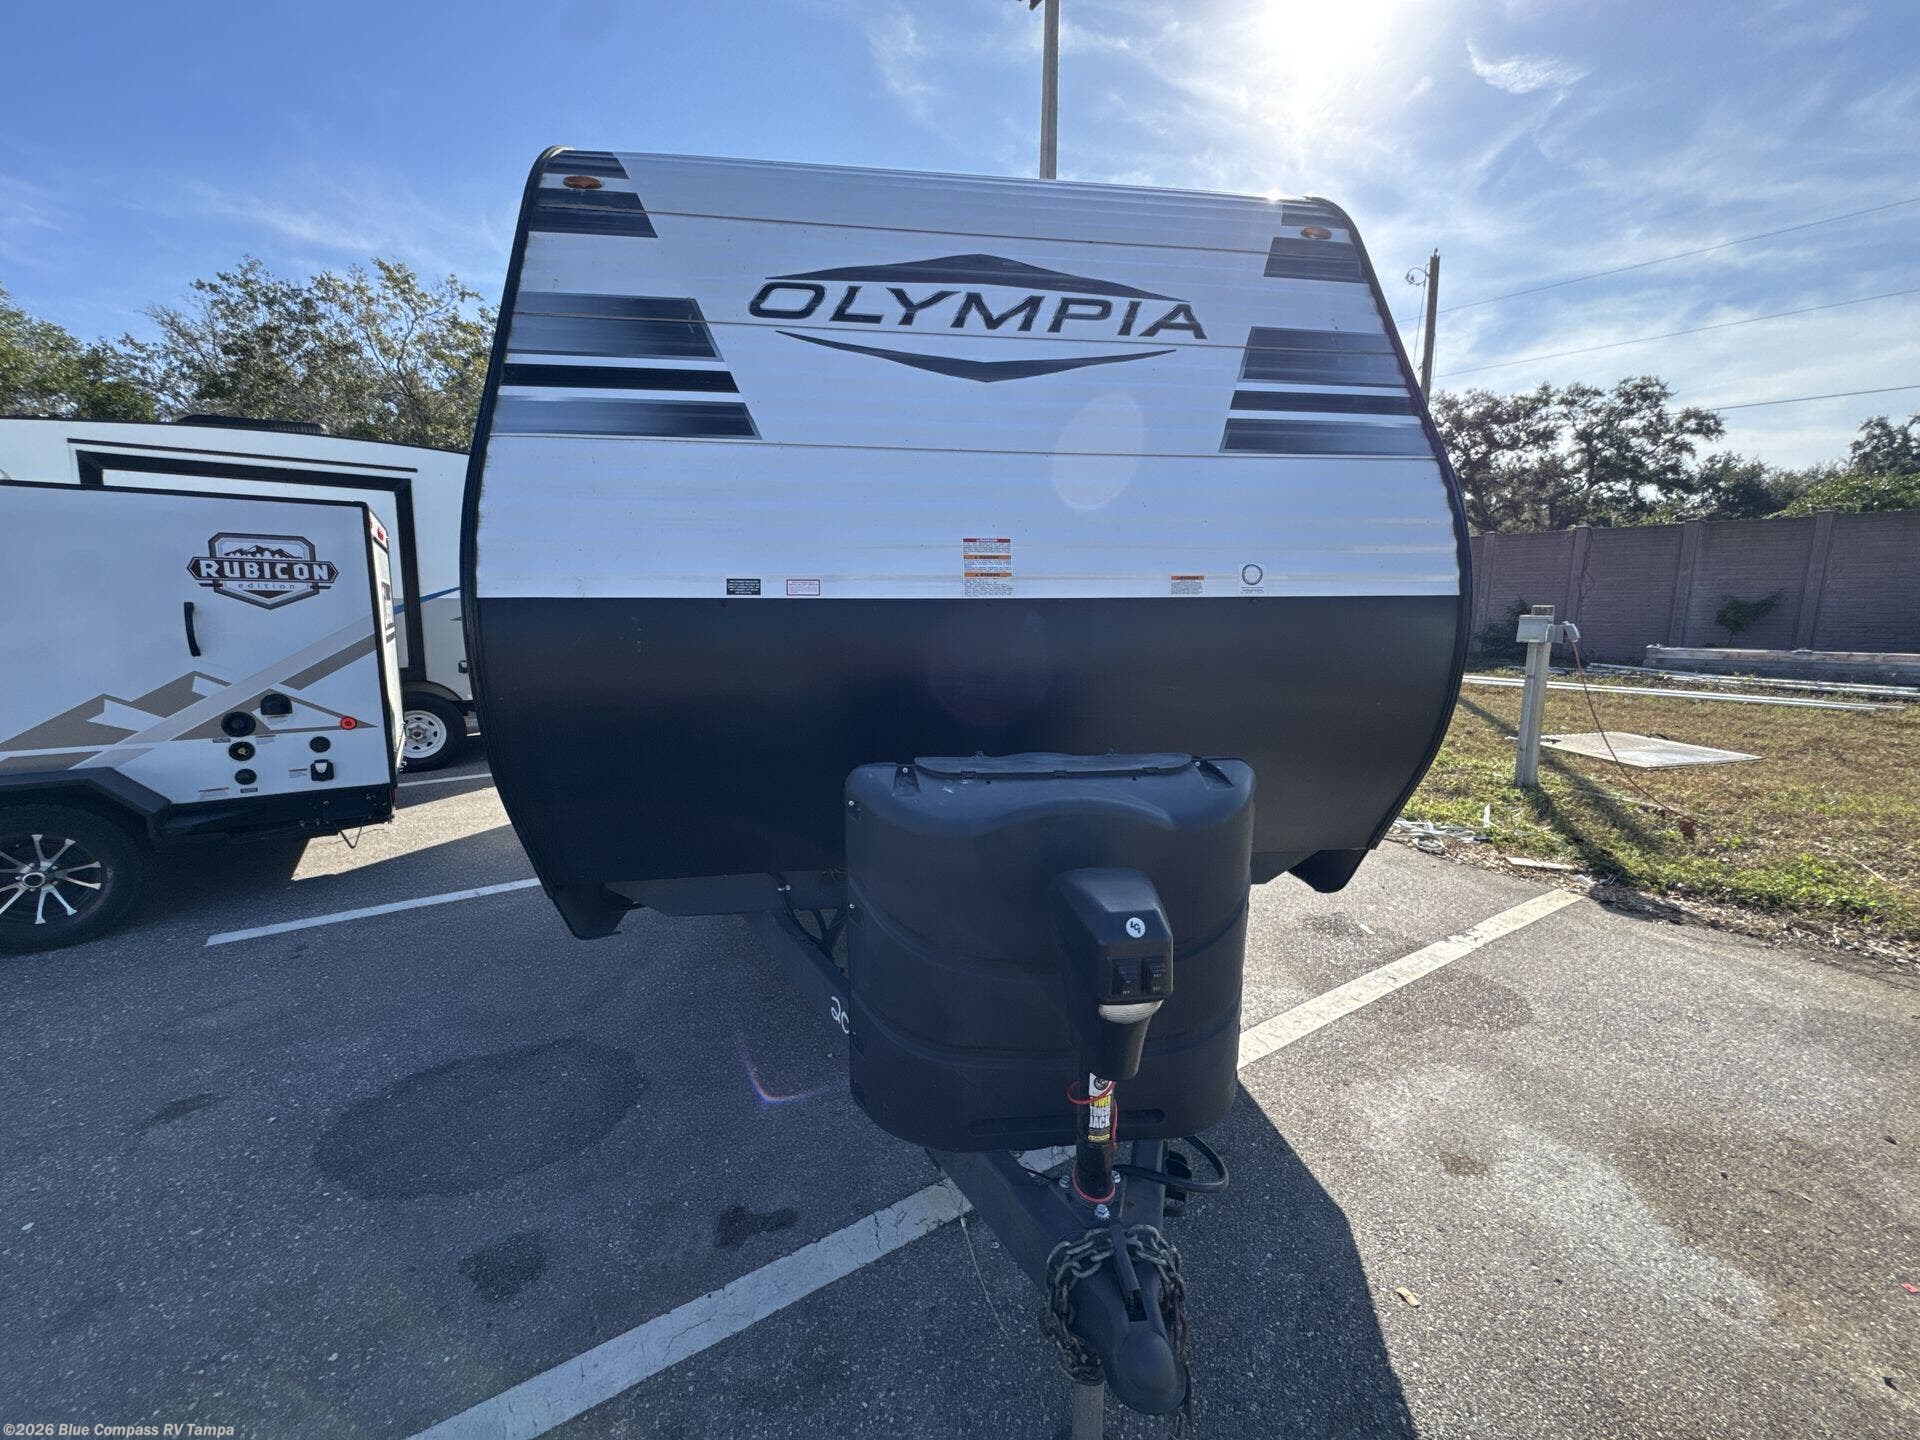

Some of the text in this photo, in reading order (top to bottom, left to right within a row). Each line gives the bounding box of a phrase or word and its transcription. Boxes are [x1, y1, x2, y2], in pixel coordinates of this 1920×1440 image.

[748, 280, 1208, 340] OLYMPIA
[199, 559, 329, 580] RUBICON
[237, 582, 296, 590] edition
[1088, 1114, 1111, 1129] JACK
